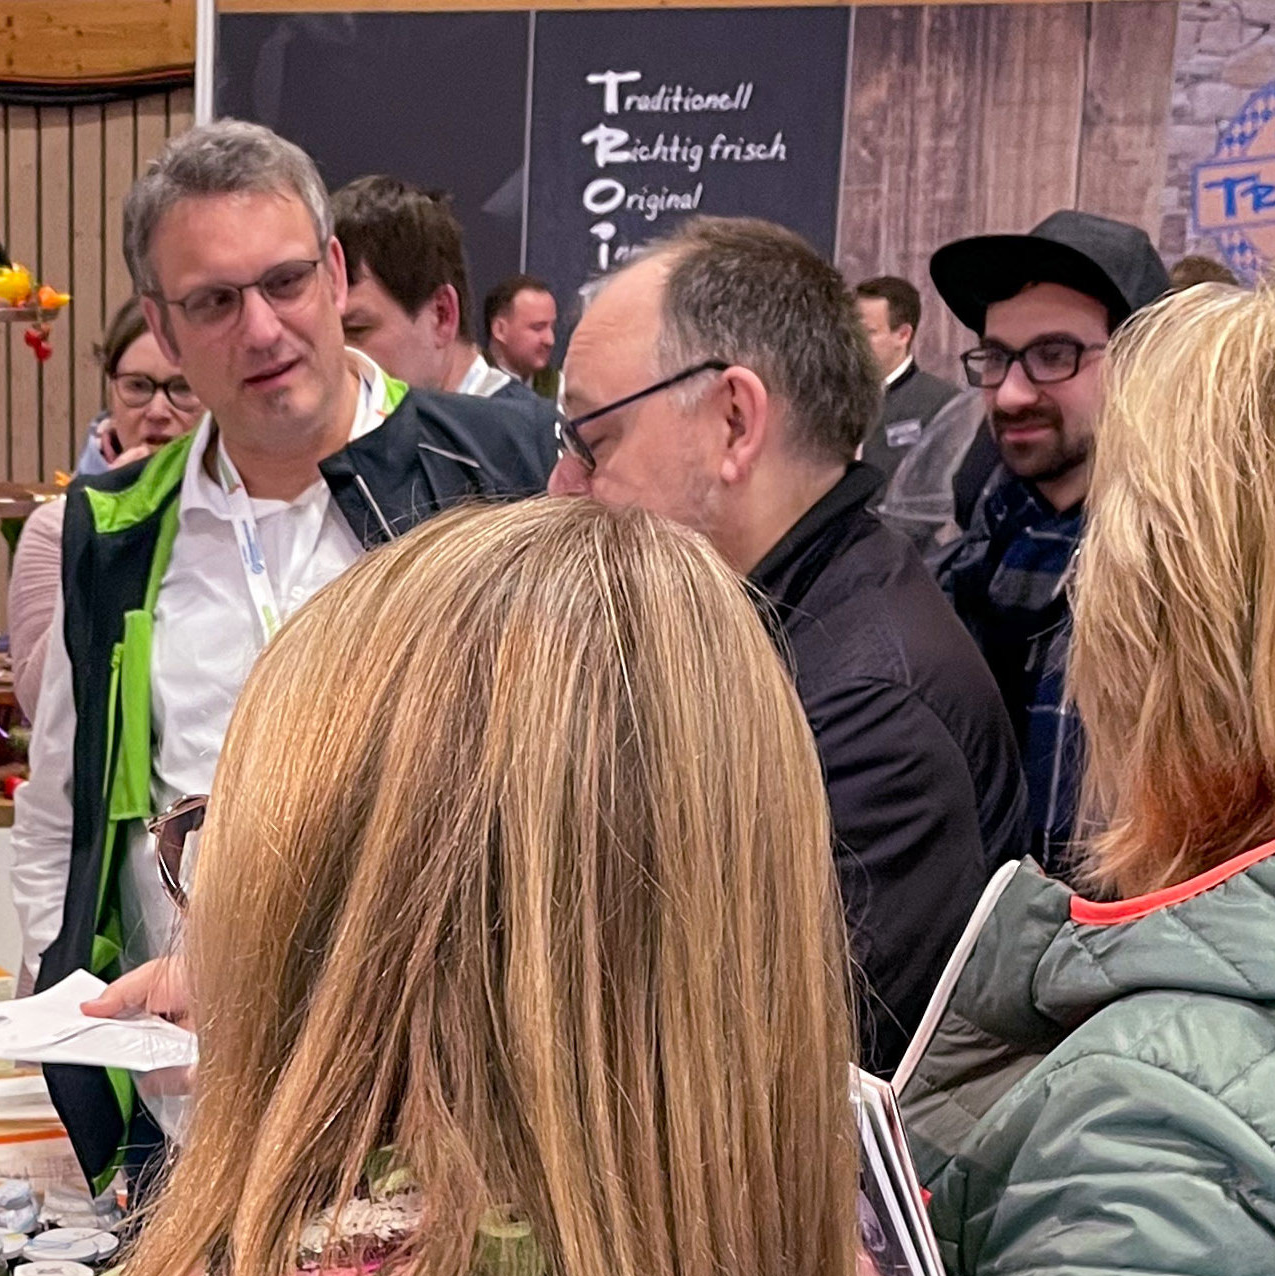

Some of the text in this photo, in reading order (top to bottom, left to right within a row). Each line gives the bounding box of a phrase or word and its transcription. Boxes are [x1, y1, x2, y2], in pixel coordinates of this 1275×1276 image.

[585, 69, 754, 115] Traditionell
[581, 122, 788, 173] Richtig frisch
[582, 178, 704, 221] Original
[1203, 173, 1275, 218] TR
